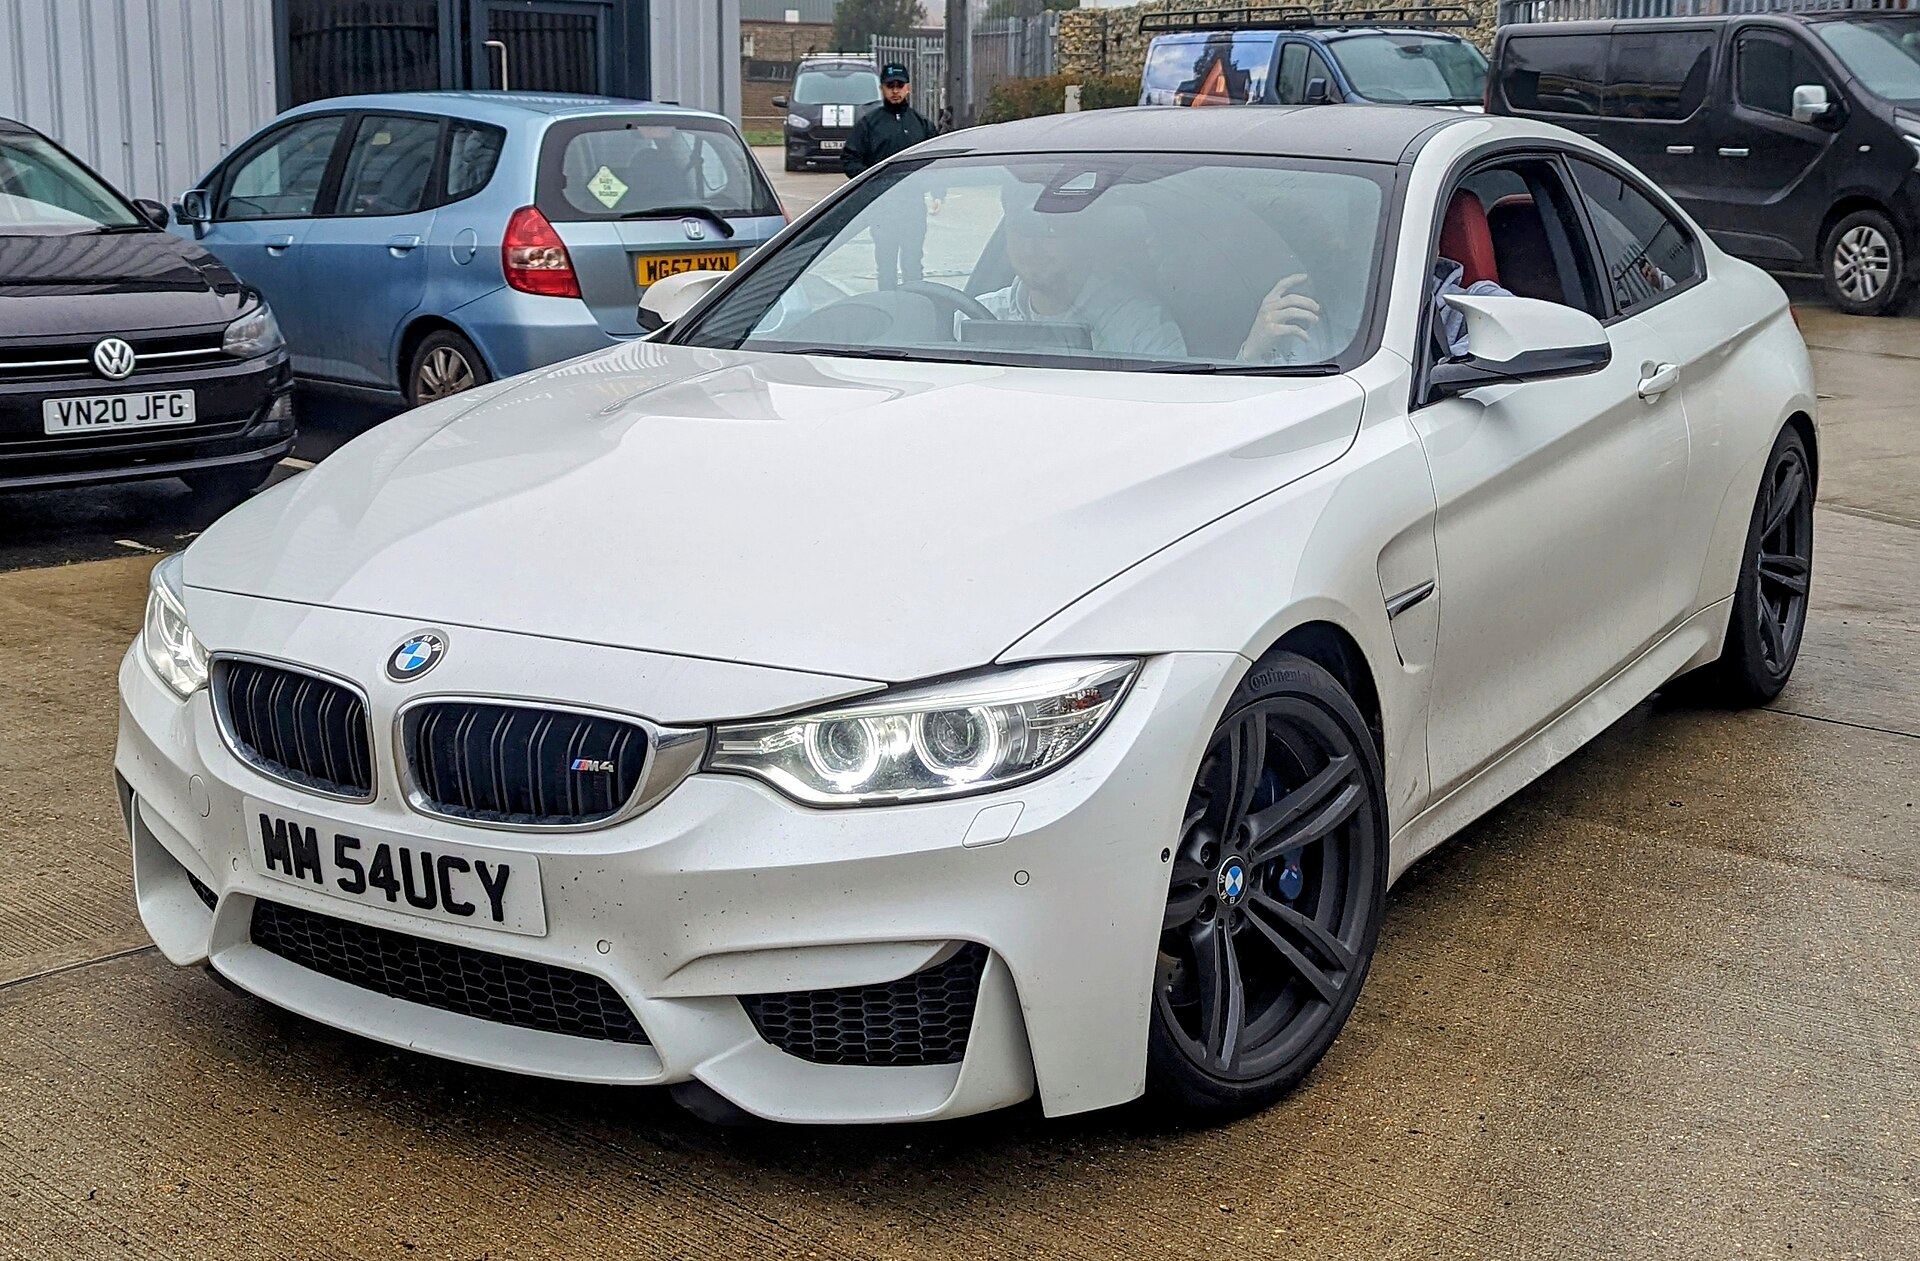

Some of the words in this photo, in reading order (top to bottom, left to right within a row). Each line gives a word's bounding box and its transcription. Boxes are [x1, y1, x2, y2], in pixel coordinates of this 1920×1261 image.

[647, 259, 692, 281] WG57
[57, 398, 127, 426] VN20
[136, 394, 184, 421] JFG
[259, 813, 324, 885] MM
[334, 833, 510, 922] 54UCY
[1219, 874, 1236, 904] BMW
